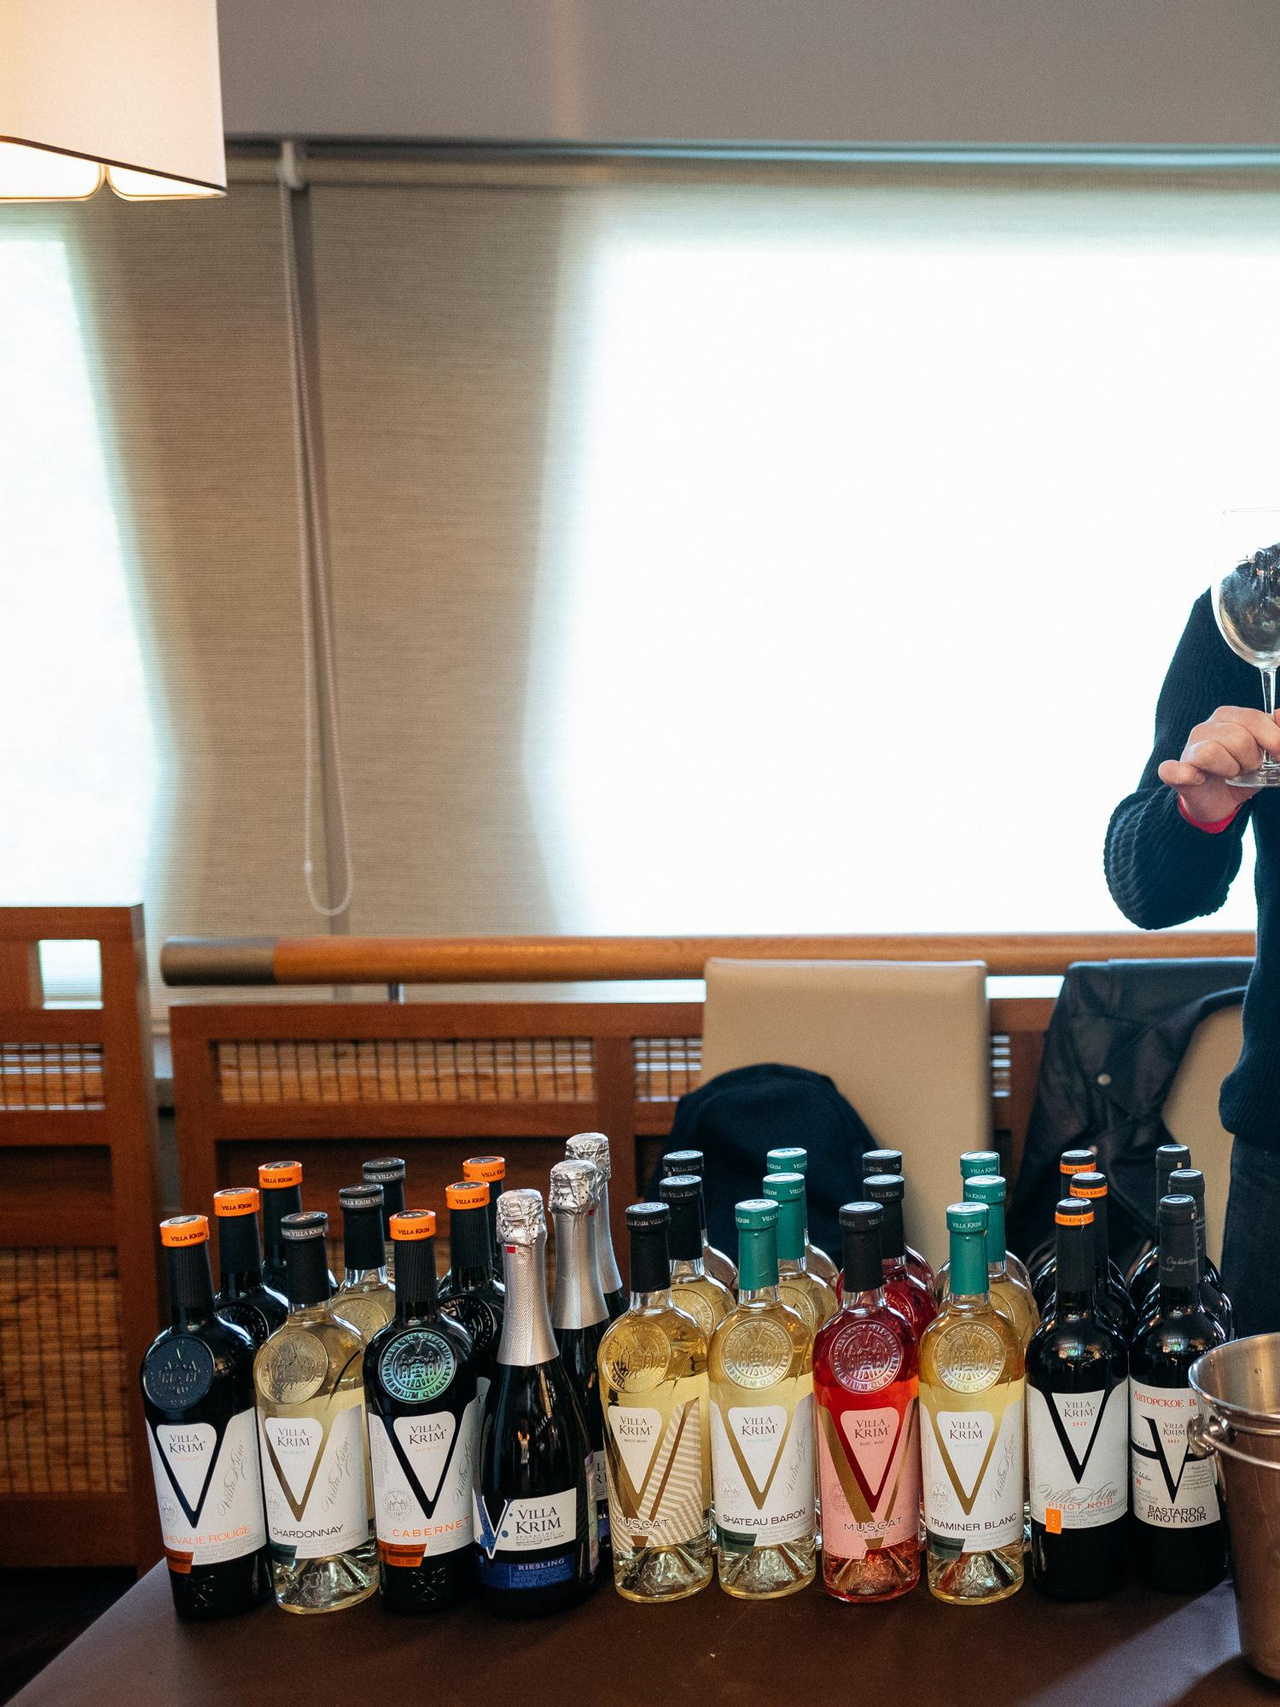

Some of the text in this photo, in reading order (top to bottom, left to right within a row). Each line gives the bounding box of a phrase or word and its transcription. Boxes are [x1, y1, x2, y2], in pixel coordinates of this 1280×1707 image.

[341, 1198, 355, 1206] VILLA
[355, 1198, 371, 1206] KRIM
[471, 1196, 485, 1204] KRIM
[967, 1221, 982, 1229] KRIM
[188, 1231, 204, 1241] KRIM
[308, 1227, 324, 1236] KRIM
[397, 1226, 430, 1236] VILLA KRIM
[1065, 1400, 1091, 1409] VILLA
[1133, 1390, 1184, 1408] АВТОРСКОЕ
[1064, 1408, 1094, 1418] KRIM
[619, 1416, 648, 1426] VILLA
[743, 1416, 773, 1425] VILLA
[856, 1418, 886, 1428] VILLA
[951, 1420, 980, 1429] VILLA
[278, 1427, 307, 1436] VILLA
[410, 1423, 442, 1434] VILLA
[619, 1424, 651, 1436] KRIM
[741, 1425, 776, 1436] KRIM
[854, 1427, 889, 1439] KRIM
[1163, 1428, 1186, 1436] KRIM
[169, 1434, 200, 1443] VILLA
[409, 1430, 446, 1445] KRIM
[949, 1429, 983, 1440] KRIM
[277, 1436, 311, 1447] KRIM
[169, 1442, 205, 1454] KRIM
[1048, 1498, 1113, 1510] PINOT NOIR
[517, 1506, 558, 1520] VILLA
[1148, 1505, 1205, 1516] BASTARDO
[615, 1515, 670, 1529] MUSCAT
[722, 1507, 806, 1527] SHATEAU BARON
[930, 1512, 1017, 1531] TRAMINER BLANC
[1147, 1512, 1207, 1523] PINOT NOIR
[391, 1515, 470, 1537] CABERNET
[515, 1517, 562, 1535] KRIM
[843, 1516, 903, 1532] MUSCAT
[208, 1525, 252, 1544] ROUGE
[272, 1524, 344, 1539] CHARDONNAY
[518, 1558, 566, 1571] RIESLING
